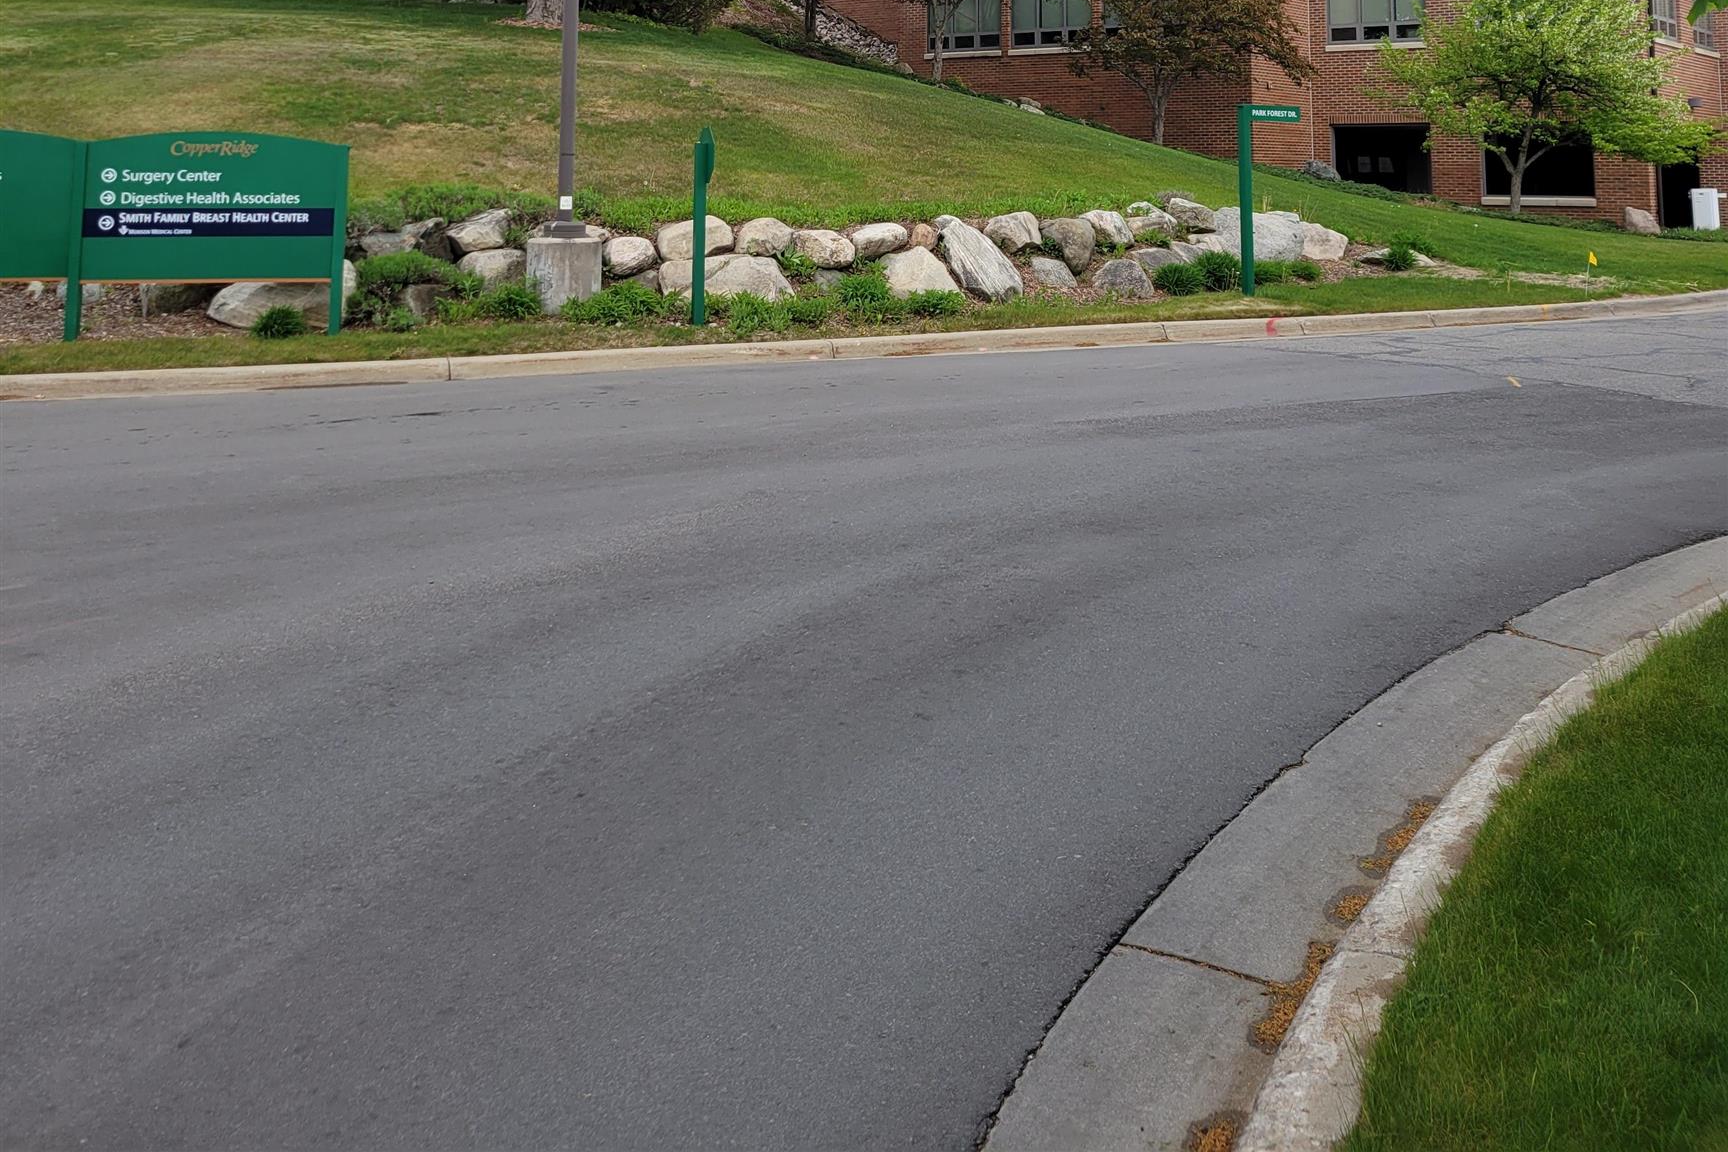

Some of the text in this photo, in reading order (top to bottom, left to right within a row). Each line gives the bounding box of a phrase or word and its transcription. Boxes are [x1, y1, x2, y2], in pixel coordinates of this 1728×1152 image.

[1252, 109, 1298, 118] PARK FOREST DR.
[122, 169, 222, 184] Surgery Center
[120, 191, 301, 207] Digestive Health Associates
[119, 212, 309, 224] SMITH FAMILY BREAST HEALTH CENTER
